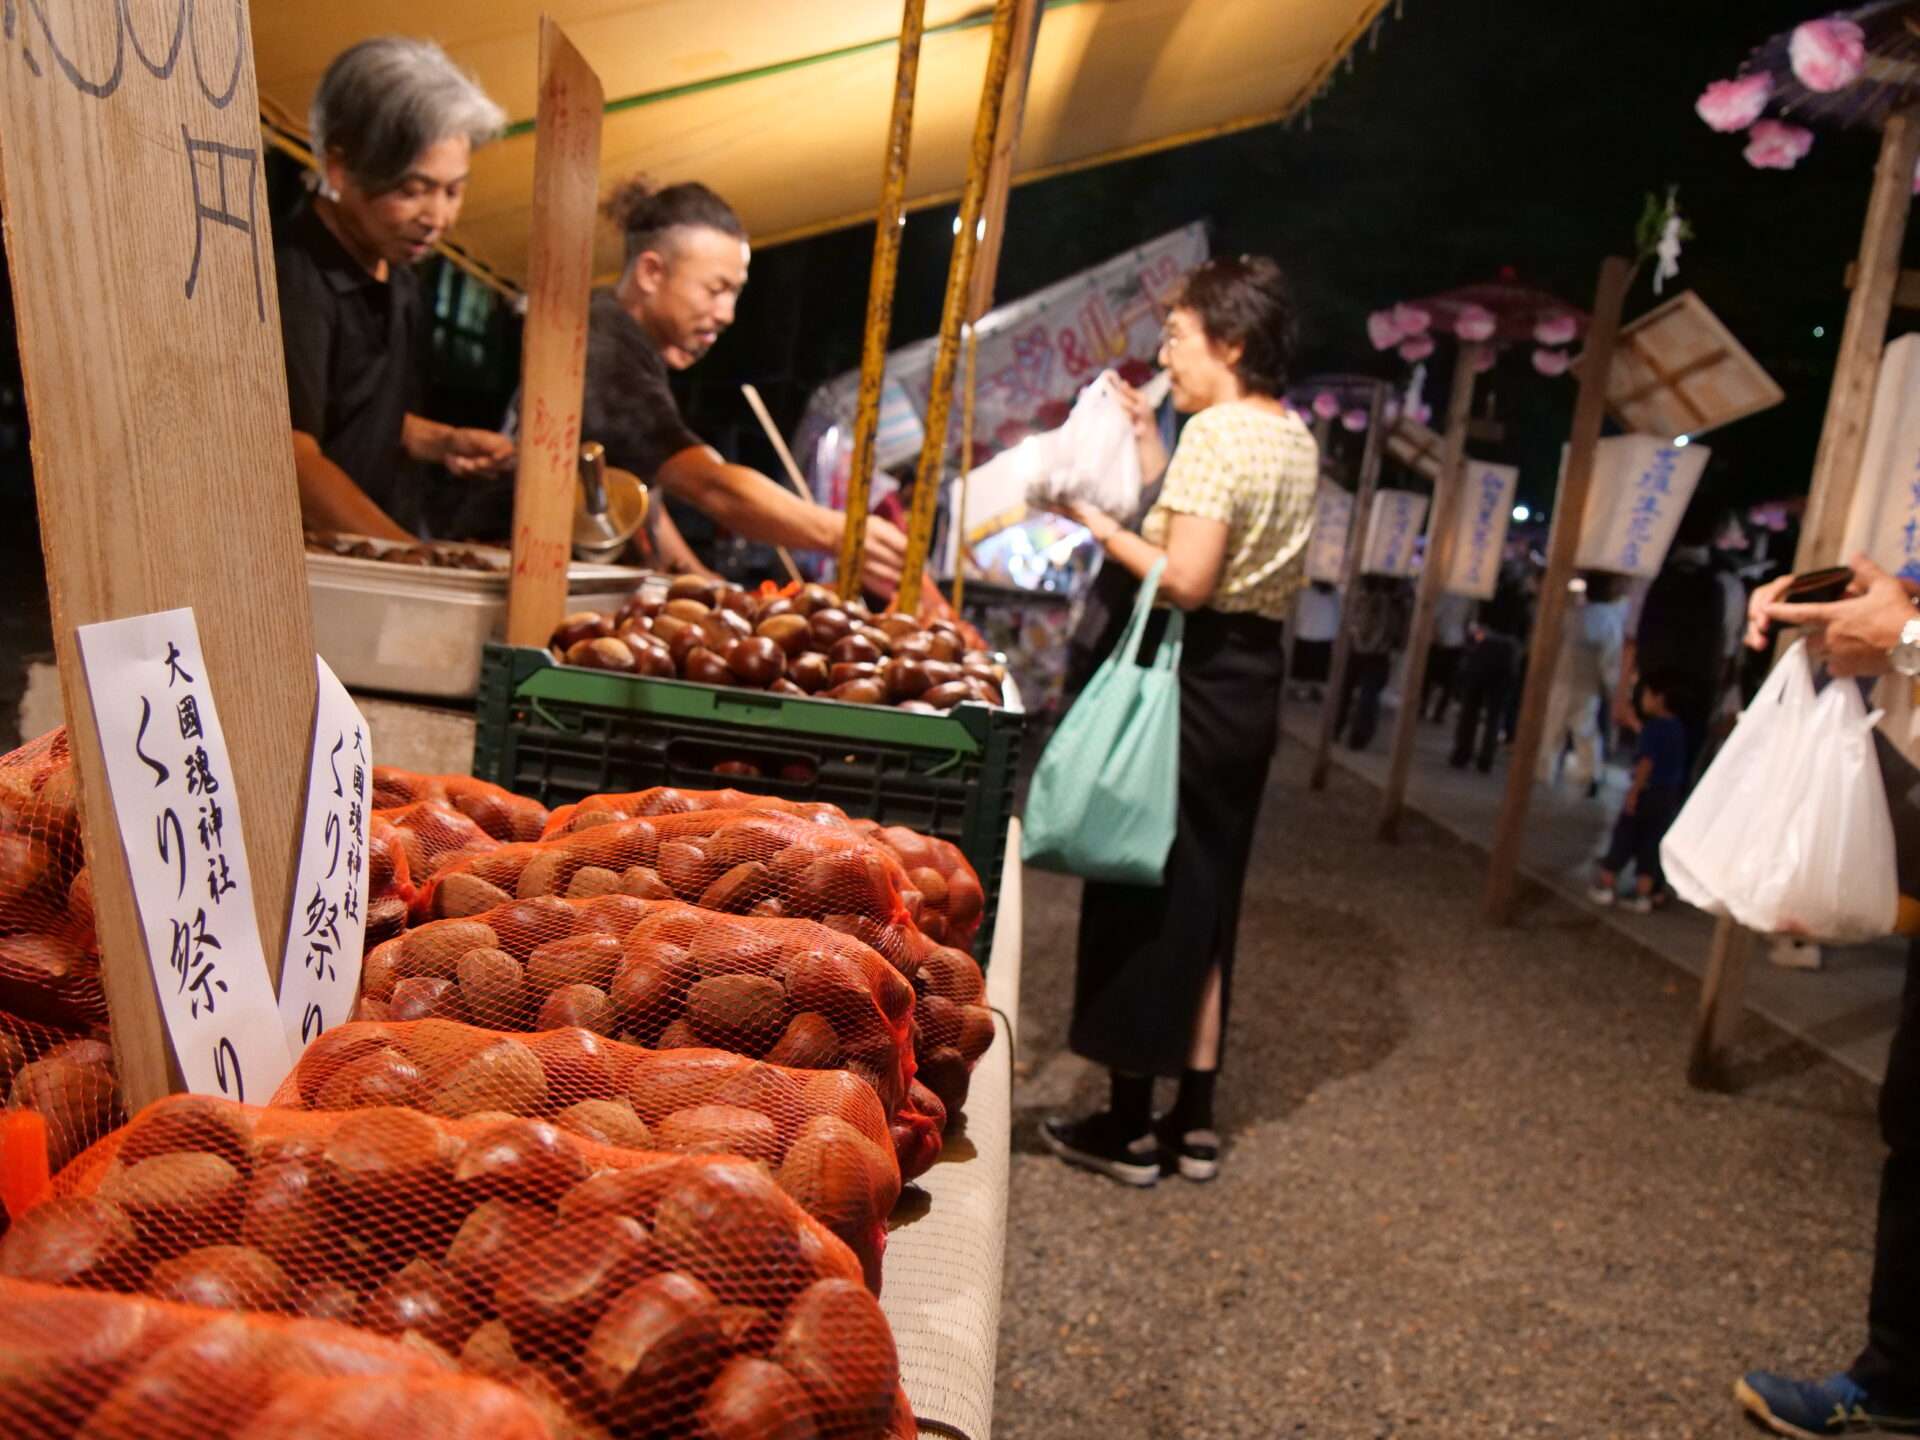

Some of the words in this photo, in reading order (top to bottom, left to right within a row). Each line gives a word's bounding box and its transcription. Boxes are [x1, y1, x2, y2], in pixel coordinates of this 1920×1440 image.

[181, 123, 266, 323] 円
[135, 695, 245, 1103] くり祭り
[164, 640, 238, 905] 大國魂神社
